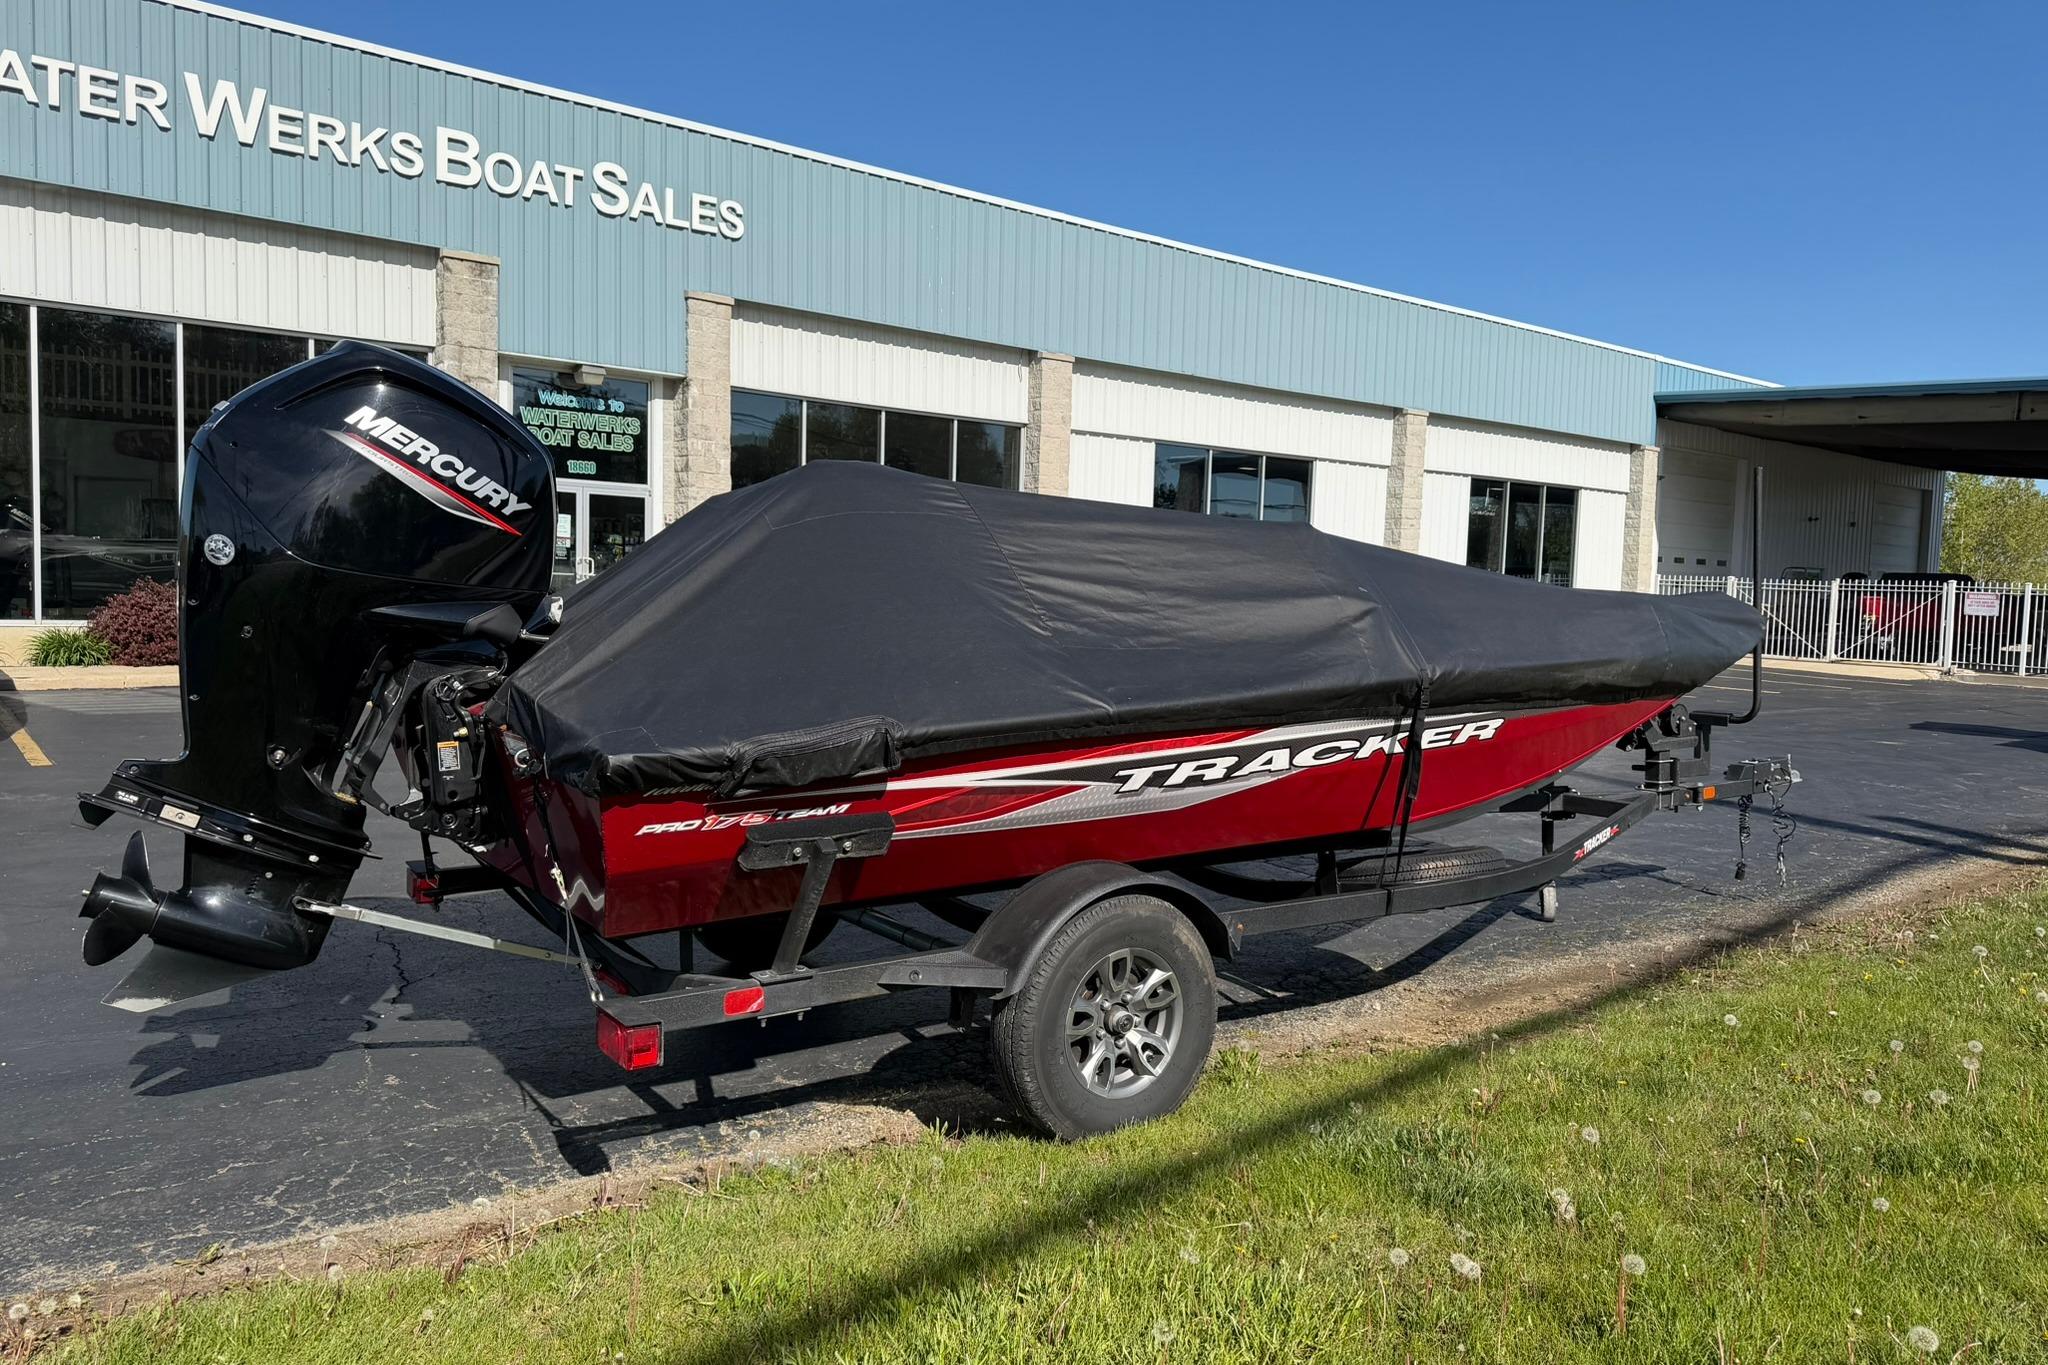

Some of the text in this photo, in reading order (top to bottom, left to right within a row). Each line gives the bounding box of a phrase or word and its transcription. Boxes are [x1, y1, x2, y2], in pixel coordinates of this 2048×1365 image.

[183, 70, 425, 179] WERKS
[434, 125, 585, 207] BOAT
[590, 161, 745, 241] SALES
[520, 406, 641, 435] WATERWERKS
[577, 430, 634, 453] SALES
[344, 405, 532, 516] MERCURY
[567, 460, 597, 475] 18660
[1114, 718, 1505, 795] TRACKER
[634, 803, 852, 837] PRO 175 TEAM
[1583, 826, 1612, 855] TRACKER
